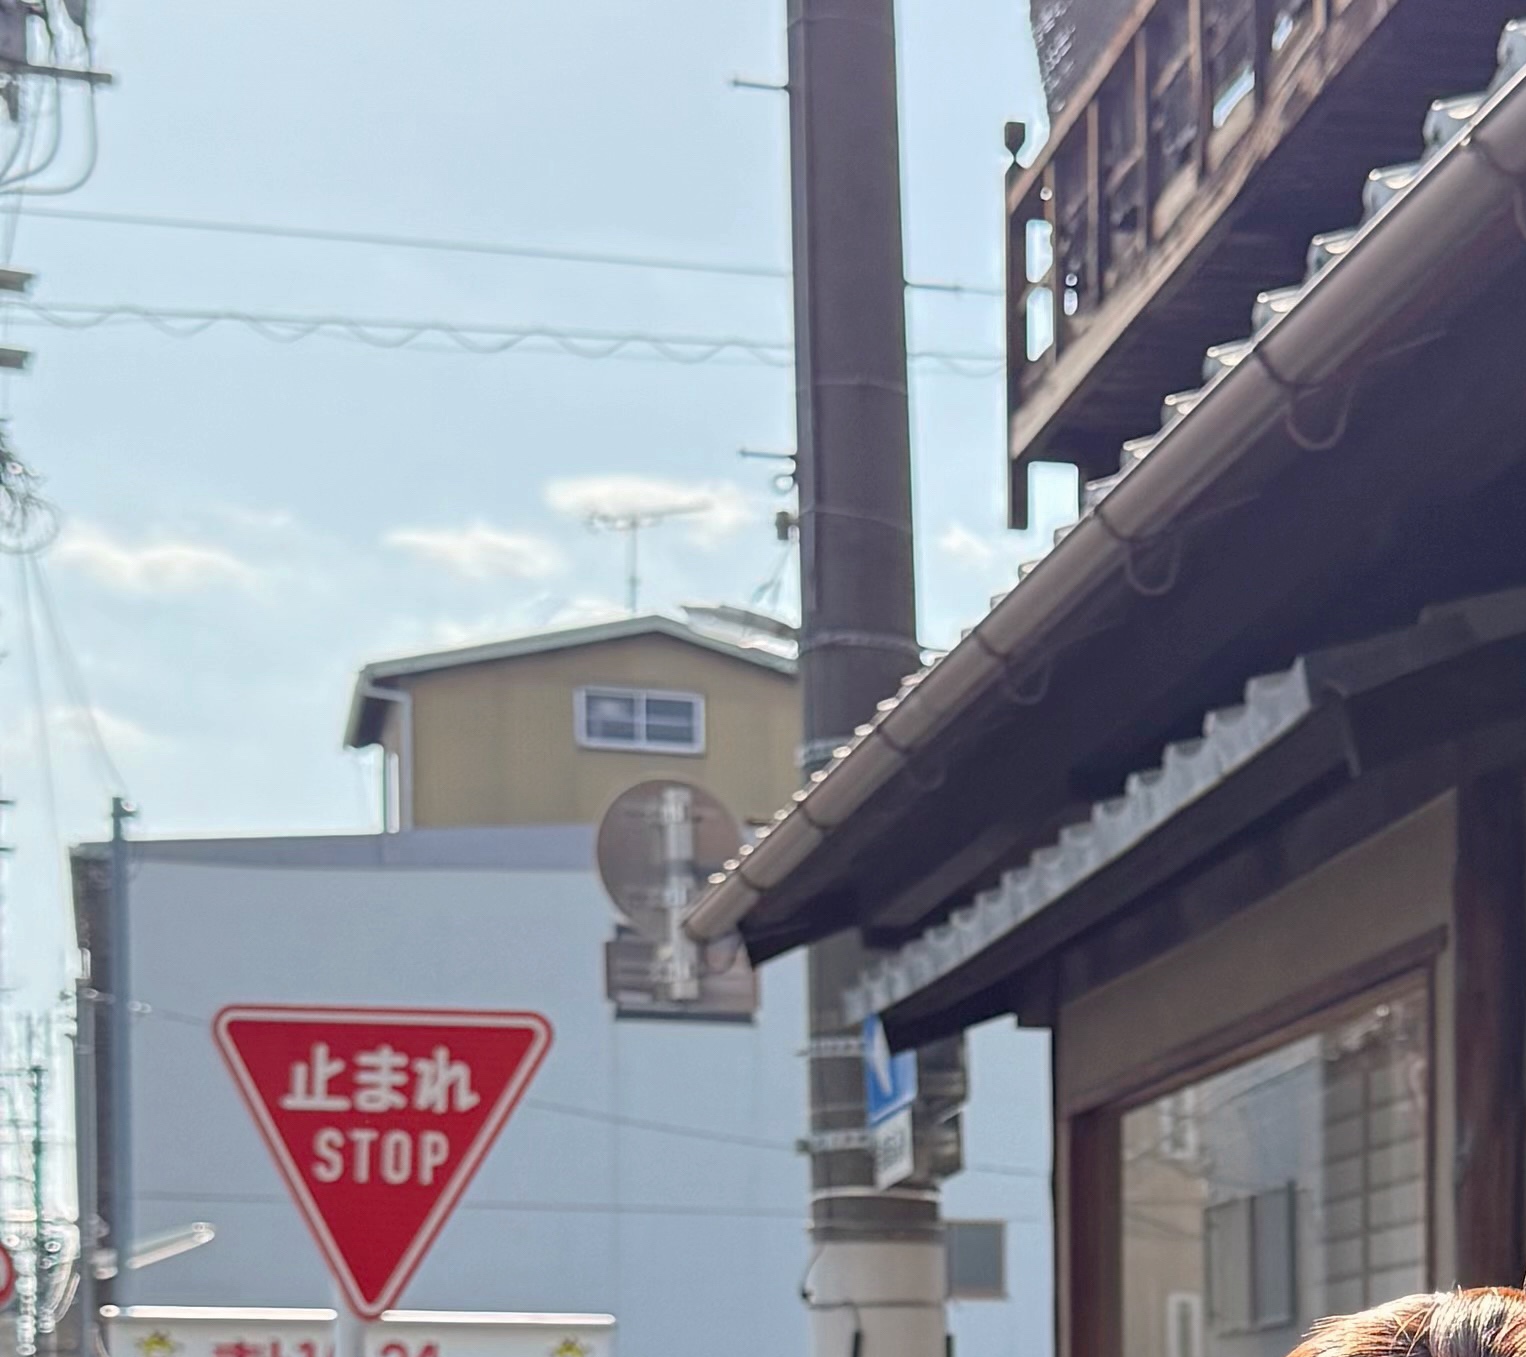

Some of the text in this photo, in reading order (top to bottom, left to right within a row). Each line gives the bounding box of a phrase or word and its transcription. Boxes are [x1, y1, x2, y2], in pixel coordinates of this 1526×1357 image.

[279, 1041, 481, 1114] 止まれ
[312, 1127, 450, 1186] STOP
